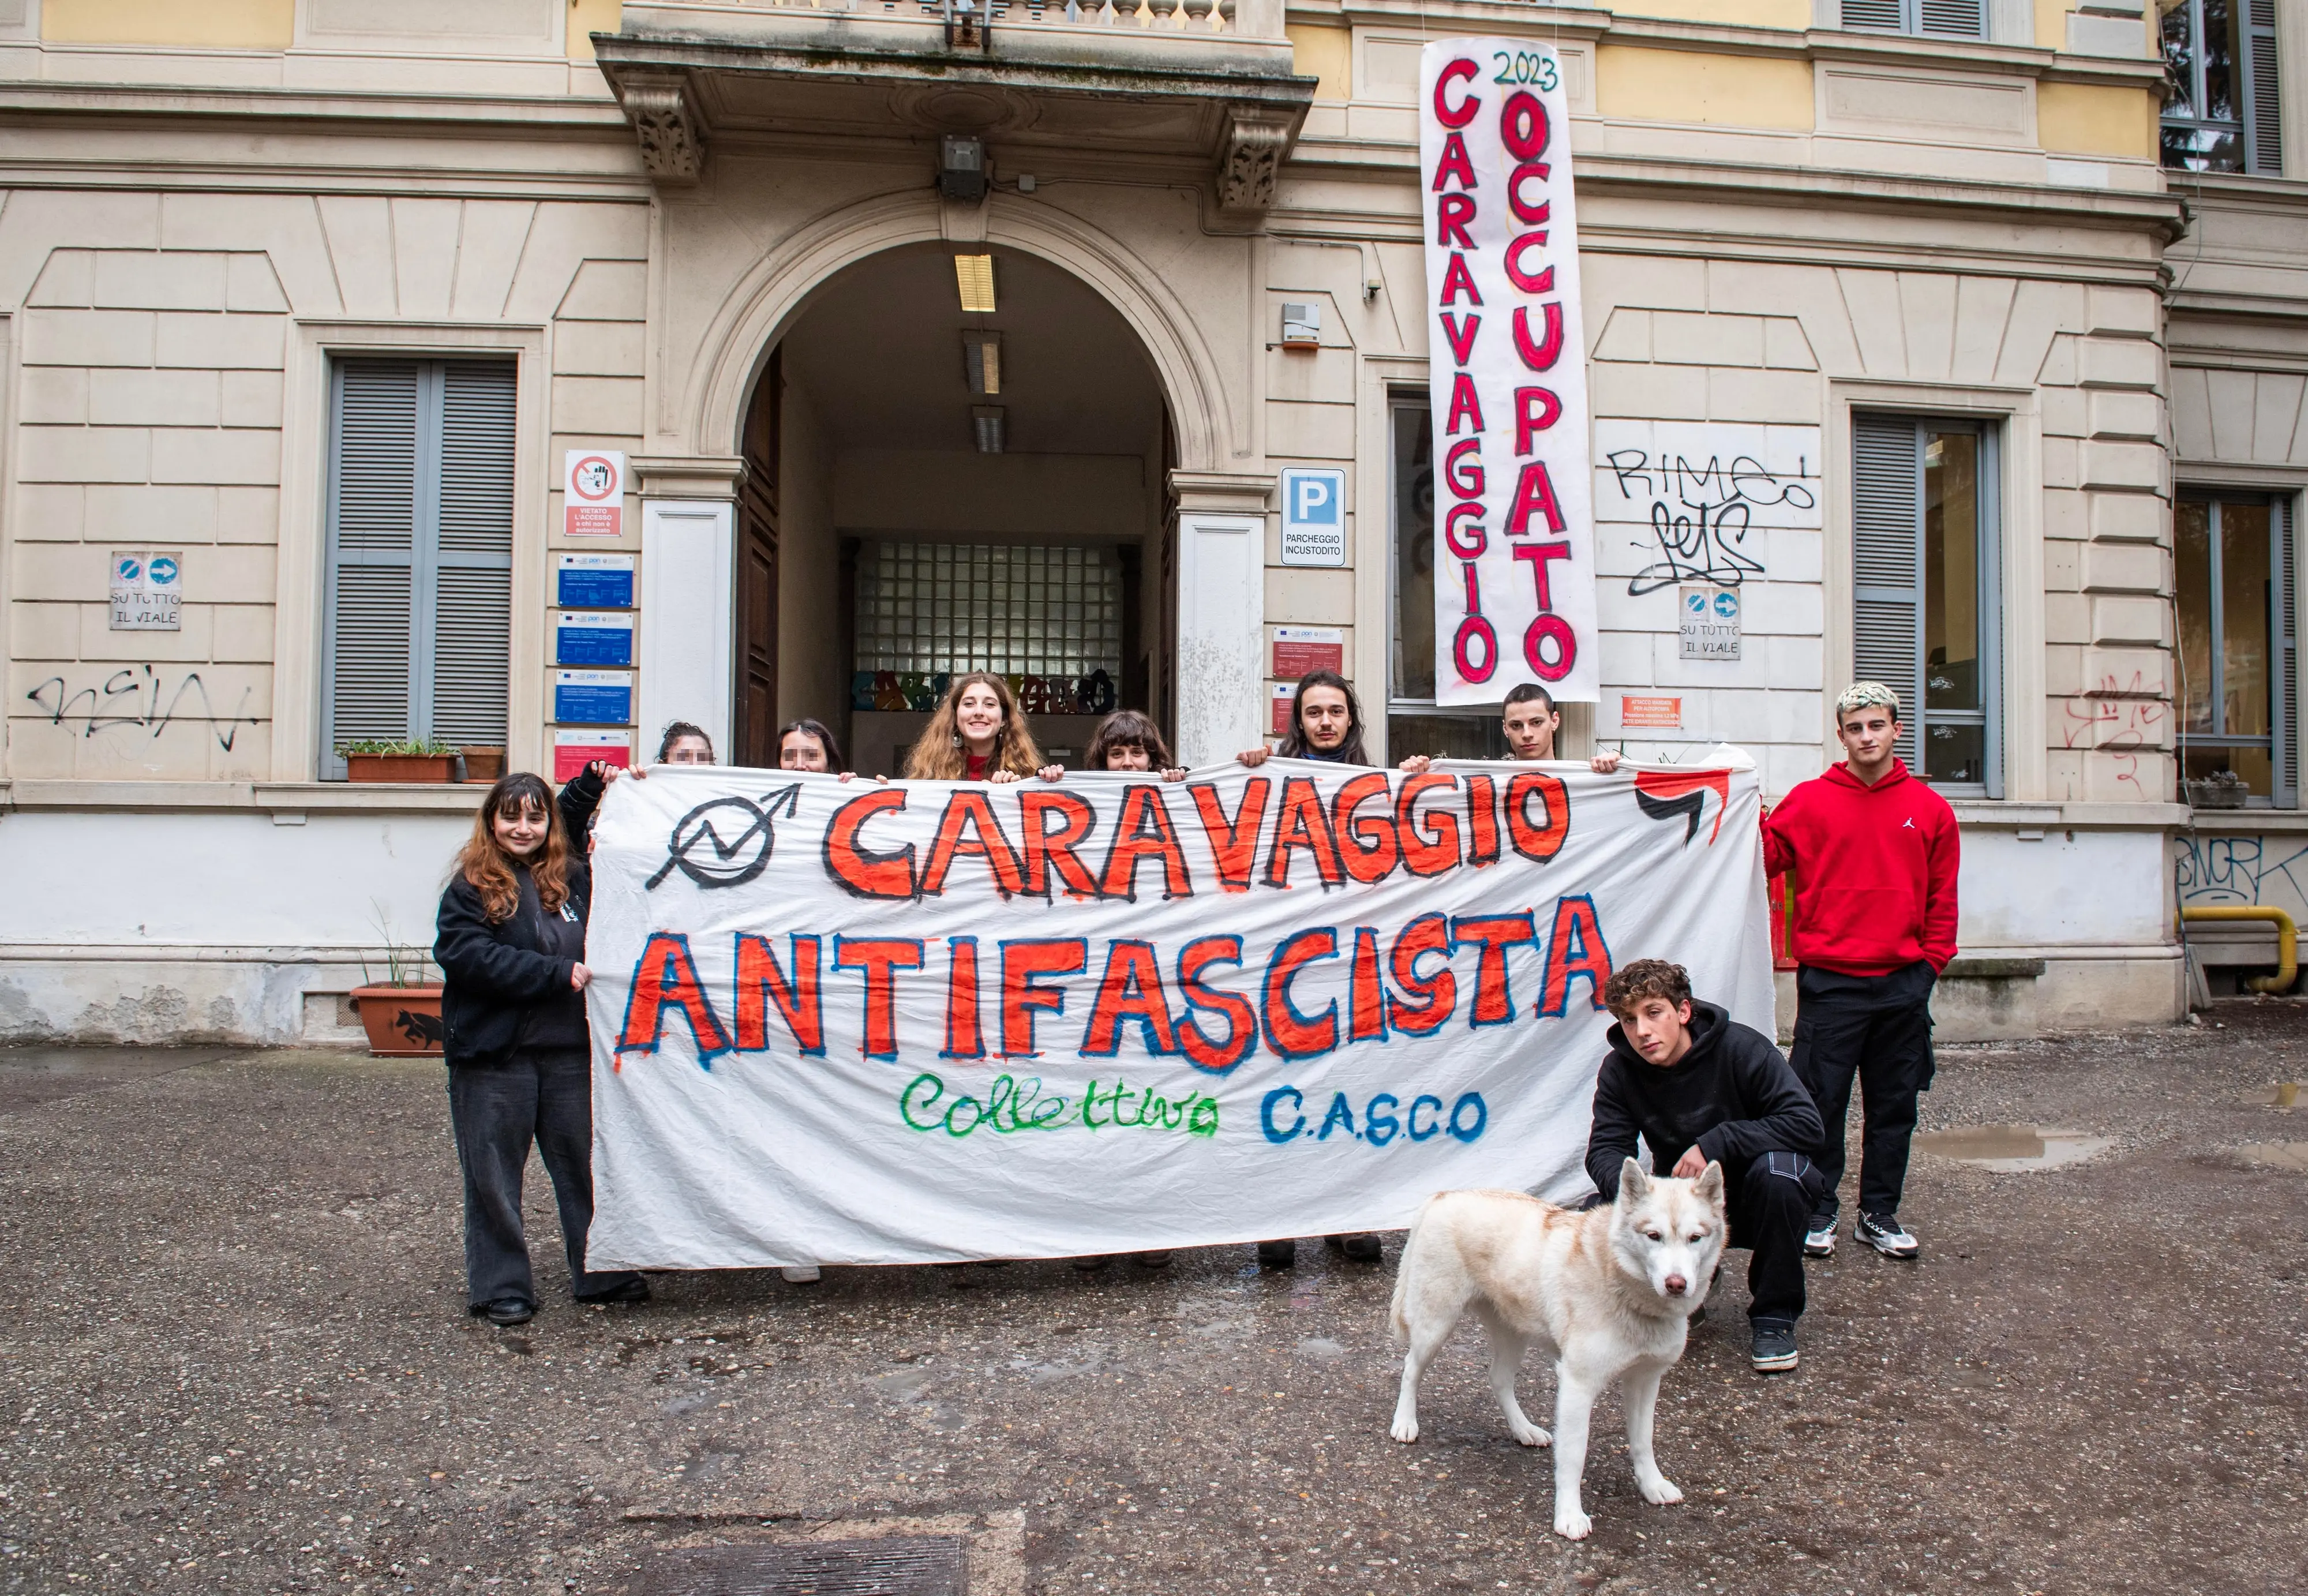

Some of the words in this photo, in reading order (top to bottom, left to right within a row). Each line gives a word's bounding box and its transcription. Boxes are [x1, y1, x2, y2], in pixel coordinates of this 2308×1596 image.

[1493, 51, 1557, 92] 2023
[1432, 58, 1498, 684] CARAVAGGIO
[1500, 91, 1578, 682] OCCUPATO
[1299, 481, 1328, 519] P
[1286, 534, 1340, 544] PARCHEGGIO
[1286, 545, 1340, 555] INCUSTODITO
[111, 593, 128, 604] SU
[133, 593, 181, 605] TUTTO
[116, 611, 131, 622] IL
[137, 612, 177, 623] VIALE
[1680, 625, 1696, 635] SU
[1686, 642, 1698, 653] IL
[1703, 642, 1738, 653] VIALE
[822, 771, 1570, 903] CARAVAGGIO
[614, 893, 1614, 1075] ANTIFASCISTA
[900, 1073, 1219, 1138] Collettivo
